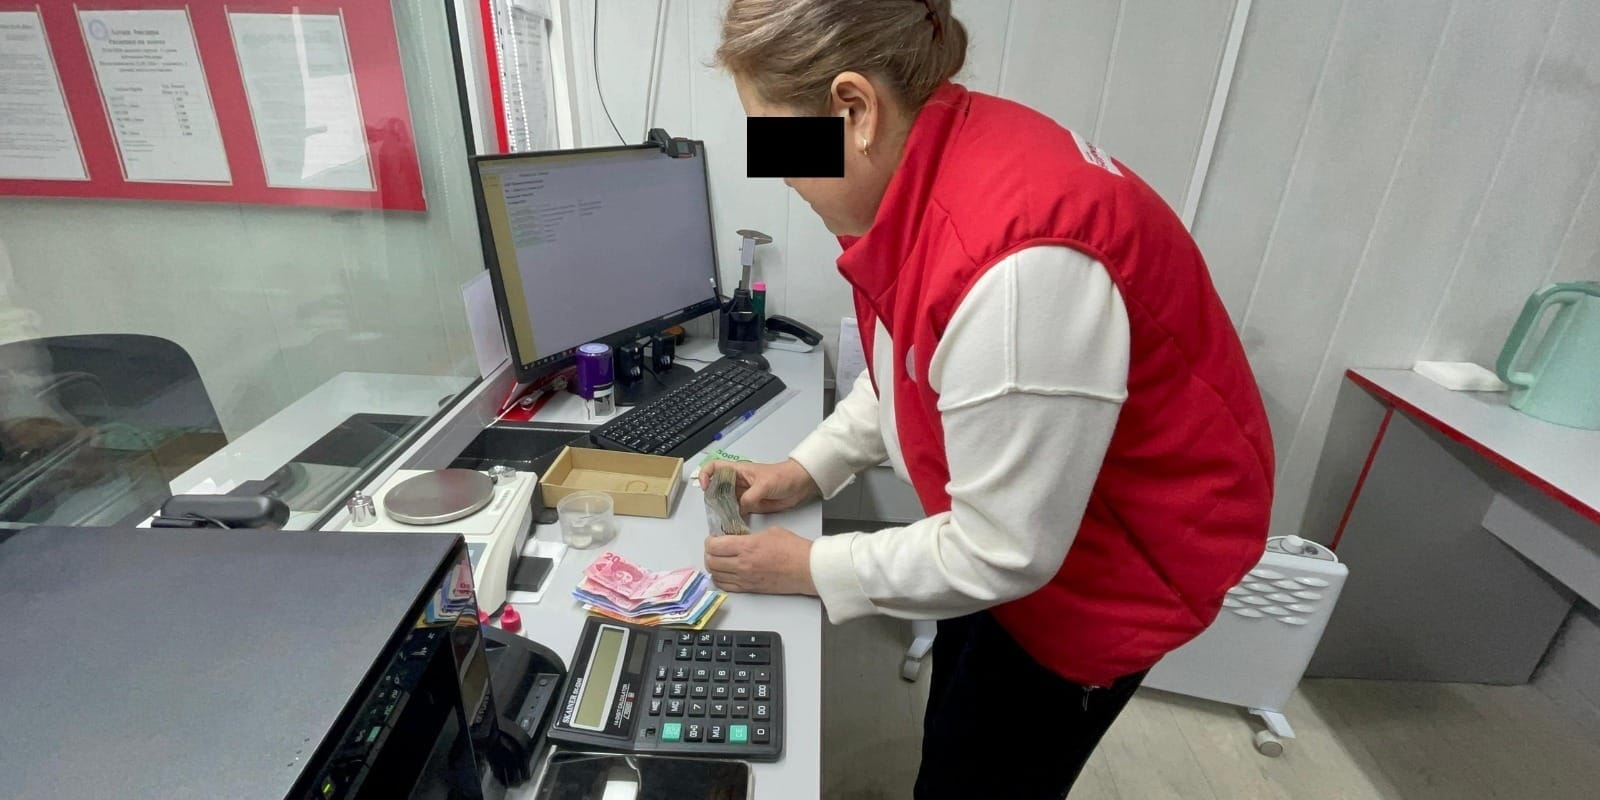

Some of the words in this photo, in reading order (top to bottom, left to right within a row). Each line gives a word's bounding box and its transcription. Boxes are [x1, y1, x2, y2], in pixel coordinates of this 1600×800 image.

[604, 552, 620, 563] 20
[758, 685, 766, 697] 000
[562, 694, 577, 723] SKAINER
[757, 705, 766, 715] 00
